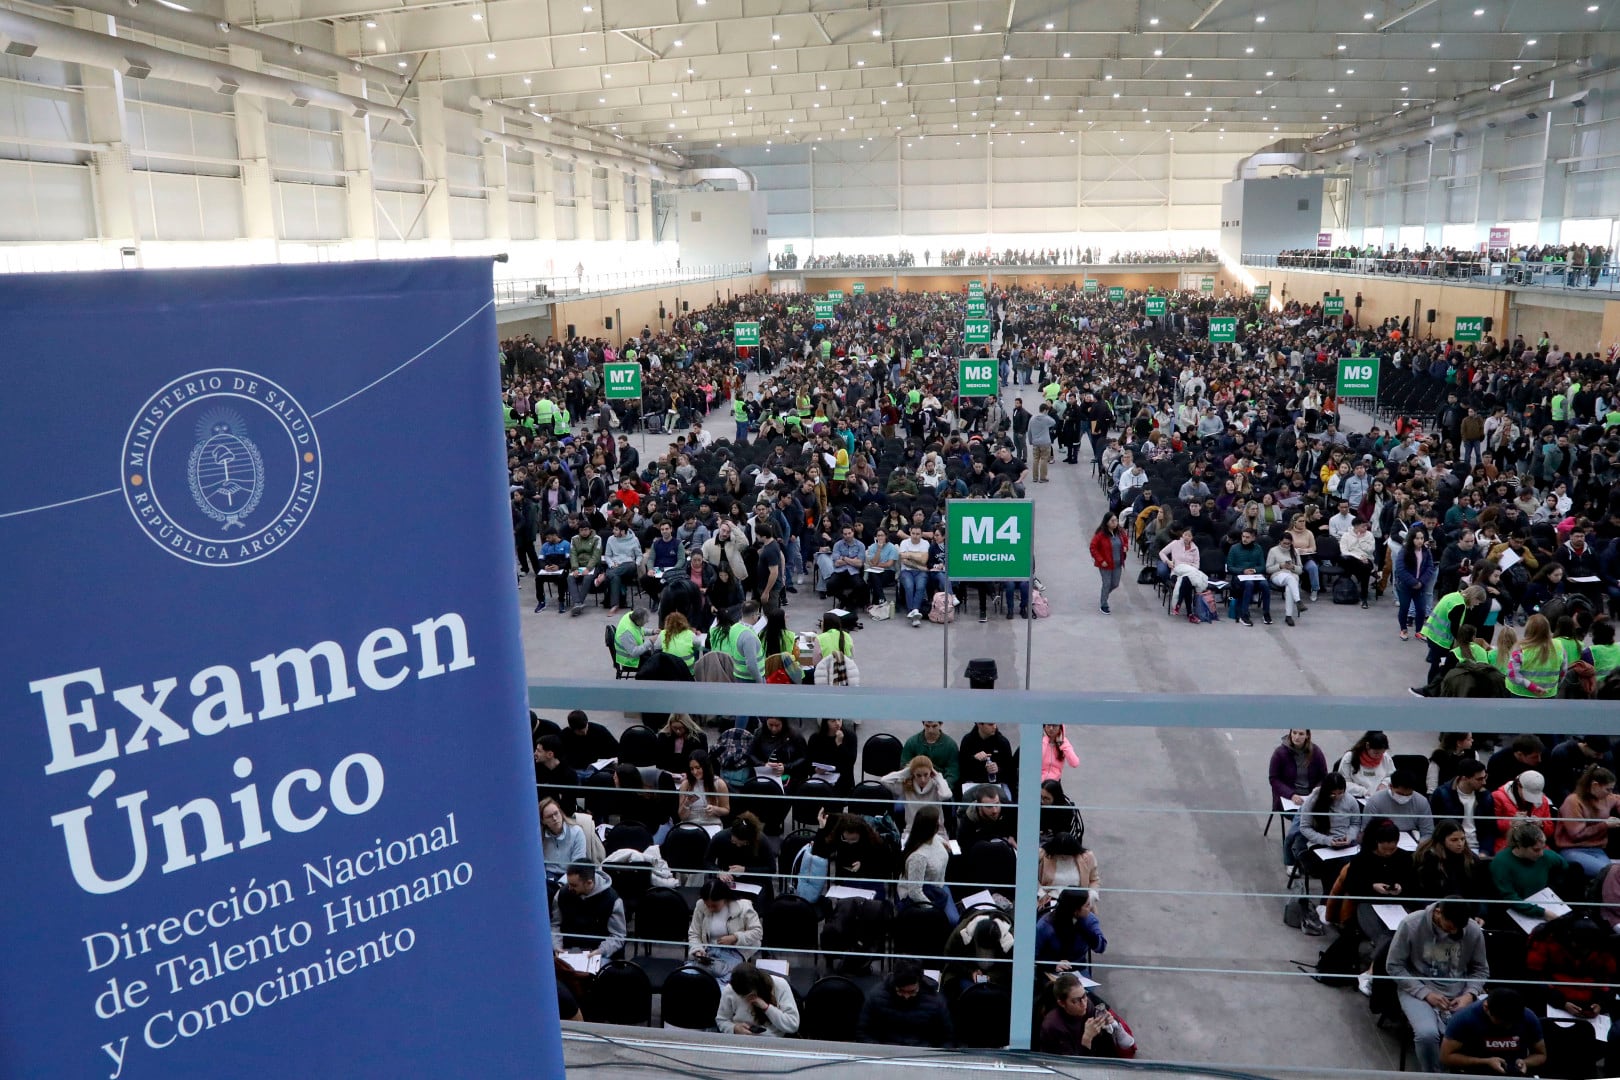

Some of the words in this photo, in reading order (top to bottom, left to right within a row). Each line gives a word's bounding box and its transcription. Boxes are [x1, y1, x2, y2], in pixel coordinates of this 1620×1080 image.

[736, 327, 757, 336] M11
[966, 324, 989, 333] M12
[1210, 323, 1234, 332] M13
[1456, 322, 1481, 331] M14
[610, 370, 635, 384] M7
[965, 366, 992, 380] M8
[1344, 365, 1373, 380] M9
[130, 376, 222, 467] MINISTERIO
[233, 377, 258, 394] DE
[265, 391, 310, 445] SALUD
[134, 492, 230, 559] REPÚBLICA
[240, 469, 315, 557] ARGENTINA
[961, 516, 1021, 545] M4
[962, 553, 1016, 561] MEDICINA
[29, 612, 475, 775] Examen
[50, 752, 385, 895] Único
[82, 878, 295, 972] Dirección
[302, 812, 460, 896] Nacional
[95, 978, 150, 1019] de
[155, 920, 312, 994] Talento
[323, 861, 474, 936] Humano
[101, 1036, 129, 1080] y
[143, 927, 416, 1049] Conocimiento
